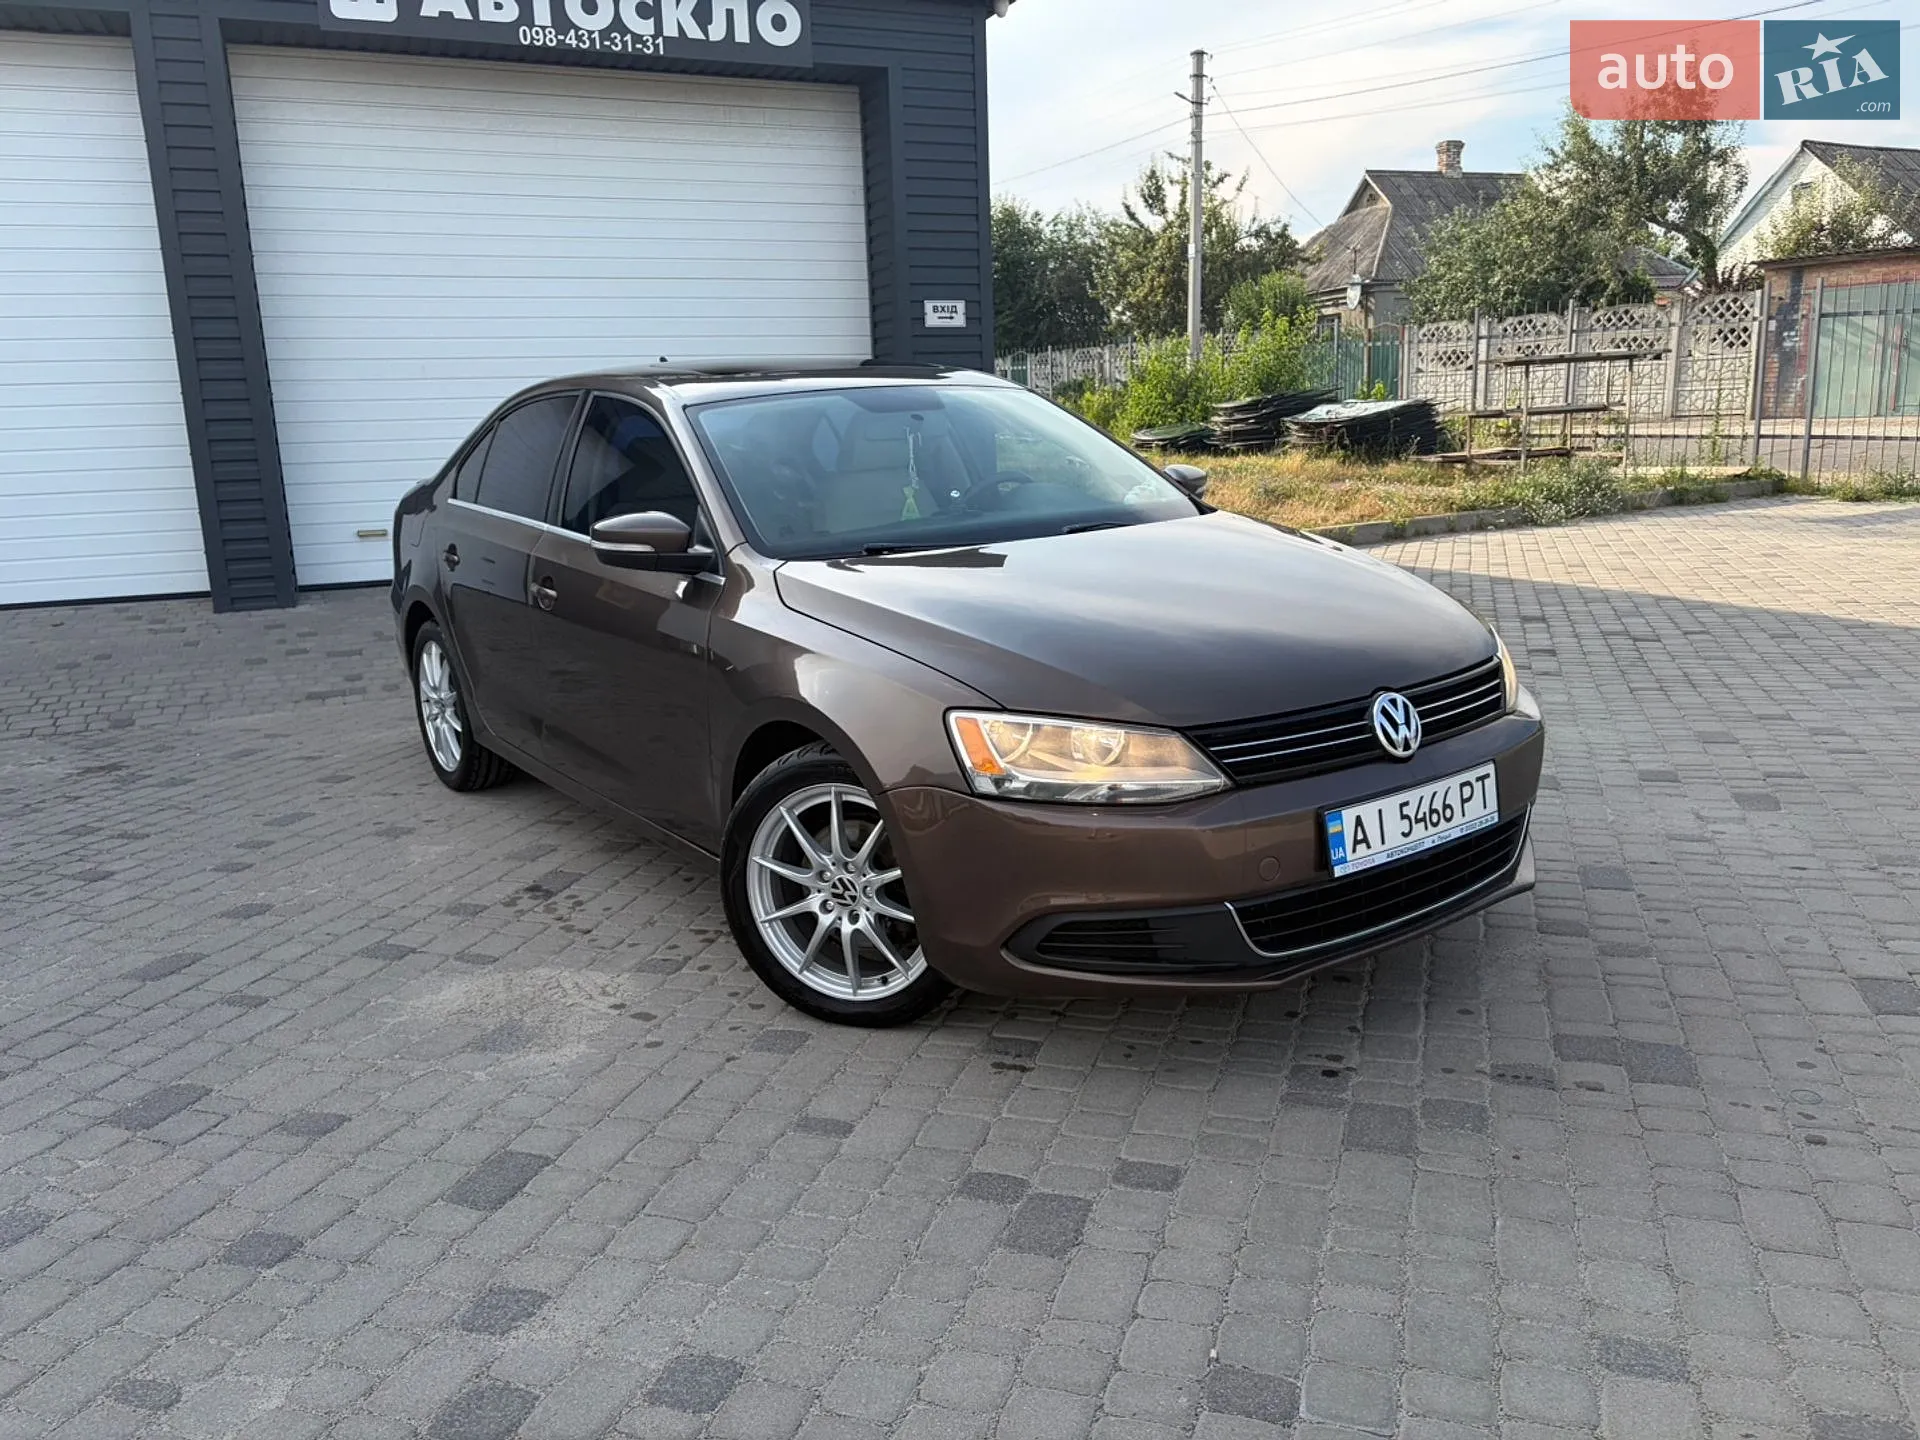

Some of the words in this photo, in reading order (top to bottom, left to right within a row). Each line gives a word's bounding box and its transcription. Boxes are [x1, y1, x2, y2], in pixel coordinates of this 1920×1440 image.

[518, 25, 664, 55] 098-431-31-31
[1398, 786, 1454, 839] 5466
[1459, 773, 1491, 818] PT
[1331, 847, 1345, 860] UA
